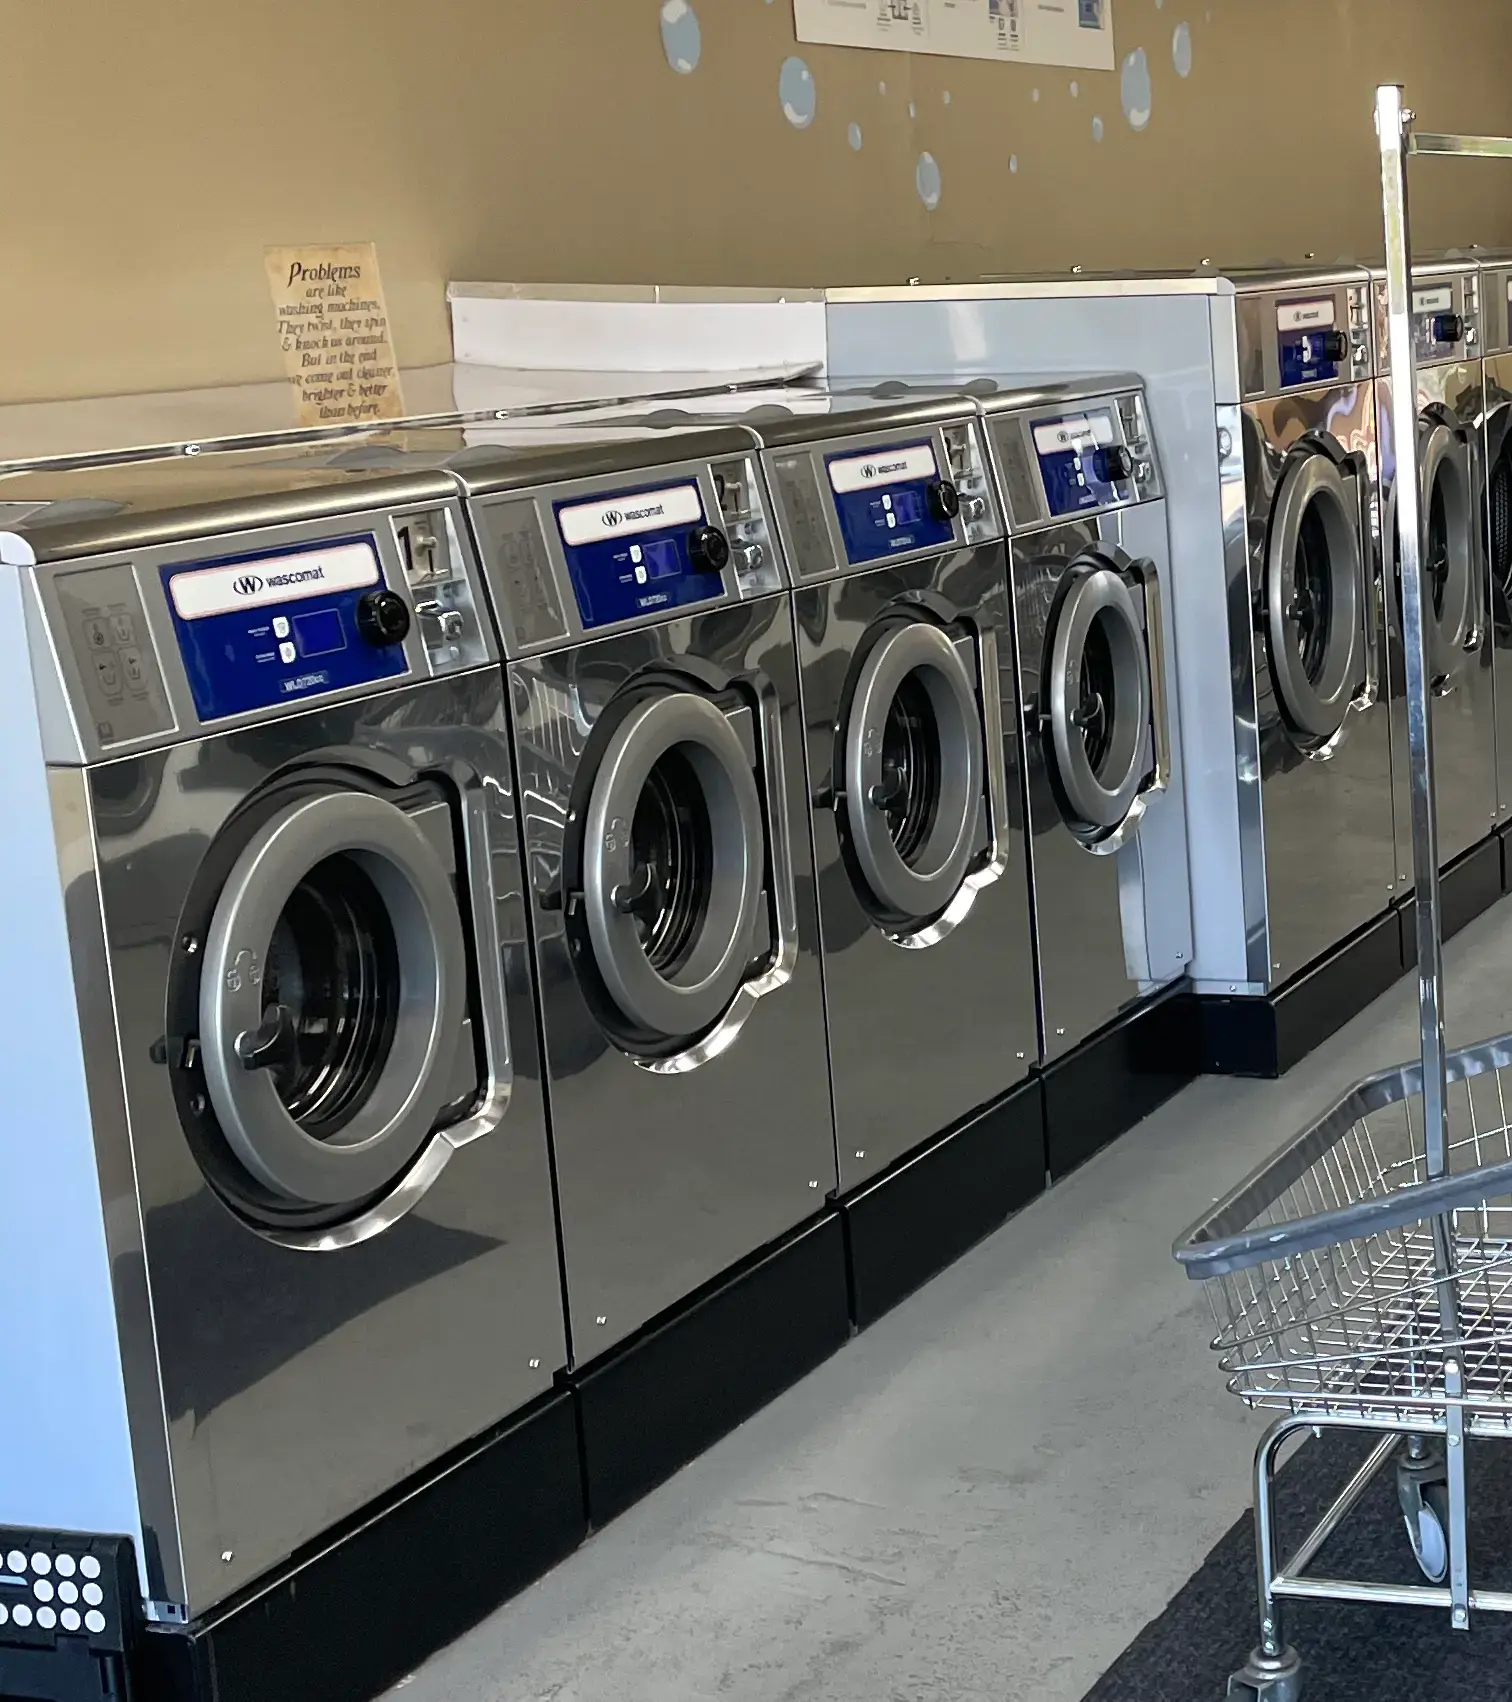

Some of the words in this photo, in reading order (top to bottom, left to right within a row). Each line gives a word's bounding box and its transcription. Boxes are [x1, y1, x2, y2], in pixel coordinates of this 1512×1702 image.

[287, 262, 361, 288] Problems
[305, 287, 325, 299] are
[327, 284, 347, 297] like
[279, 303, 323, 320] washing
[278, 320, 304, 337] They
[340, 317, 362, 331] they
[364, 317, 386, 331] spin
[282, 337, 292, 351] &
[295, 336, 329, 350] knock
[331, 339, 342, 347] us
[302, 353, 321, 367] But
[326, 355, 337, 364] in
[340, 350, 355, 364] the
[358, 349, 377, 363] end
[305, 372, 333, 384] come
[336, 368, 353, 380] out
[302, 388, 345, 405] brighter
[347, 382, 357, 397] &
[359, 384, 388, 397] better
[319, 406, 345, 418] than
[624, 504, 664, 521] wascomat
[266, 566, 324, 587] wascomat
